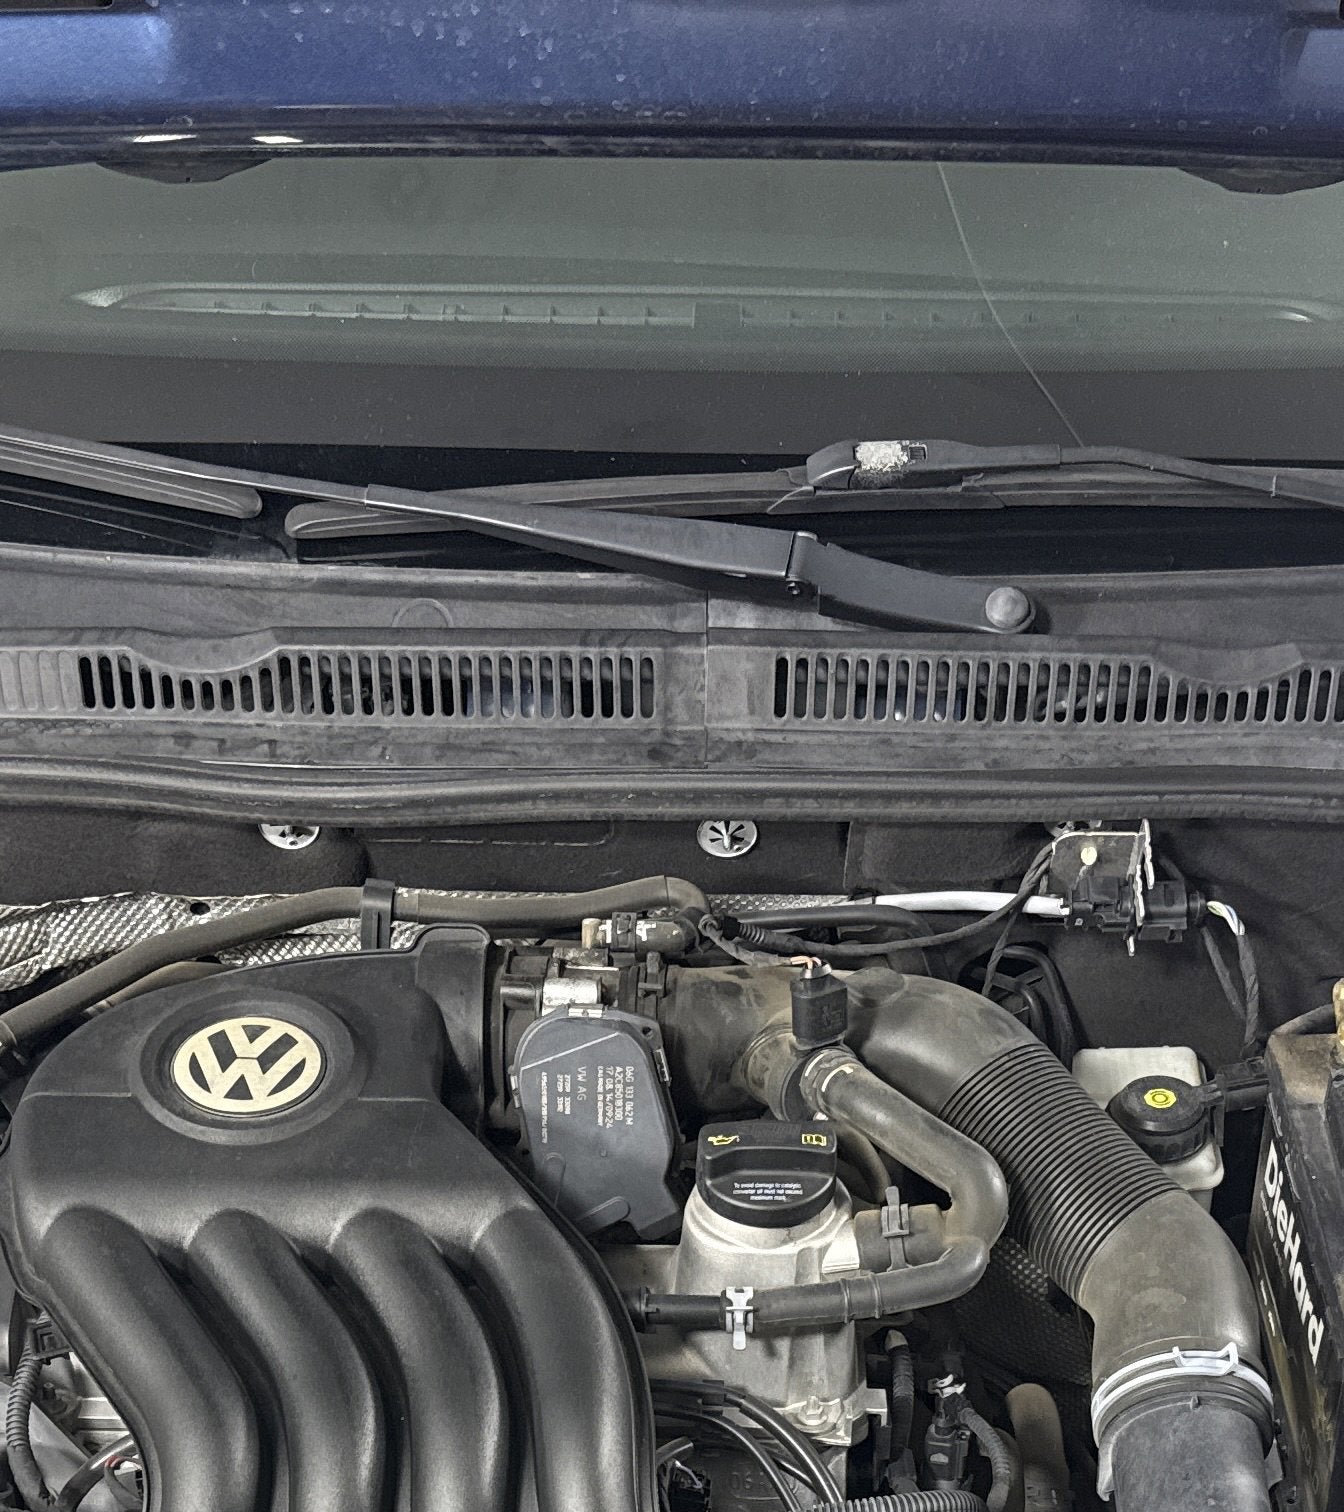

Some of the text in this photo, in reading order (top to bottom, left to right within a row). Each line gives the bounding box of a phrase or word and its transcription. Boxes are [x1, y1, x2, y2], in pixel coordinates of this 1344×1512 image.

[577, 1066, 587, 1101] VW AG
[1264, 1139, 1325, 1367] DieHard
